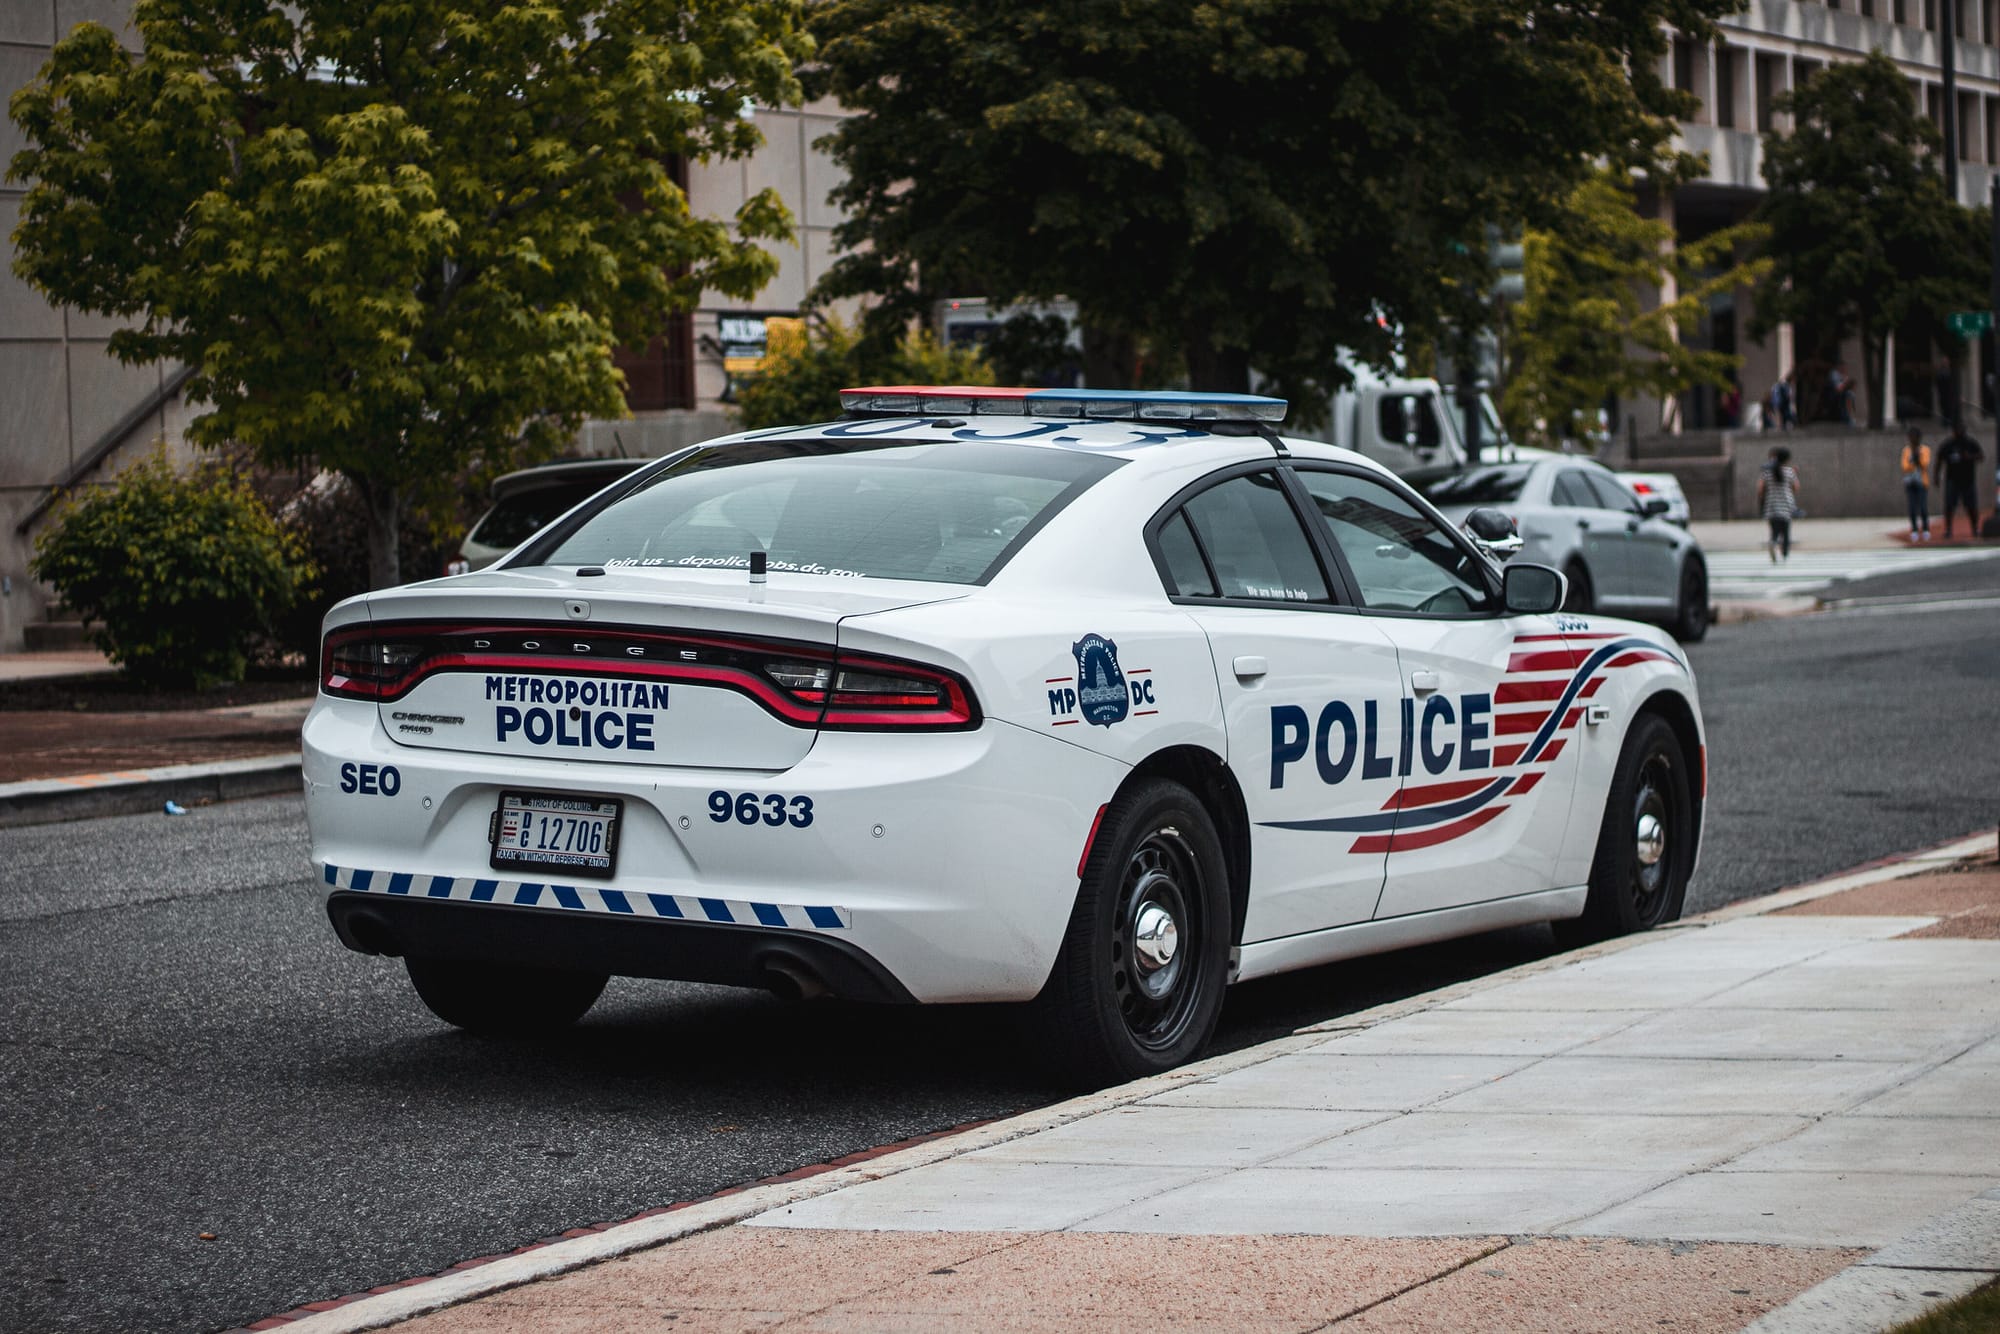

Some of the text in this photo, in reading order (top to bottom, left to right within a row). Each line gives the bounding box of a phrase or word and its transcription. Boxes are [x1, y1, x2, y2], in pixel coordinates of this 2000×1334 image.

[642, 558, 664, 566] us
[679, 555, 866, 579] dcpolicobs.dc.gov
[474, 640, 698, 660] DODGE
[485, 675, 669, 709] METROPOLITAN
[1047, 679, 1156, 715] MP DC
[496, 705, 655, 751] POLICE
[1270, 693, 1491, 789] POLICE
[340, 762, 402, 797] SEO
[552, 800, 562, 810] OF
[707, 790, 814, 829] 9633
[537, 816, 603, 854] 12706
